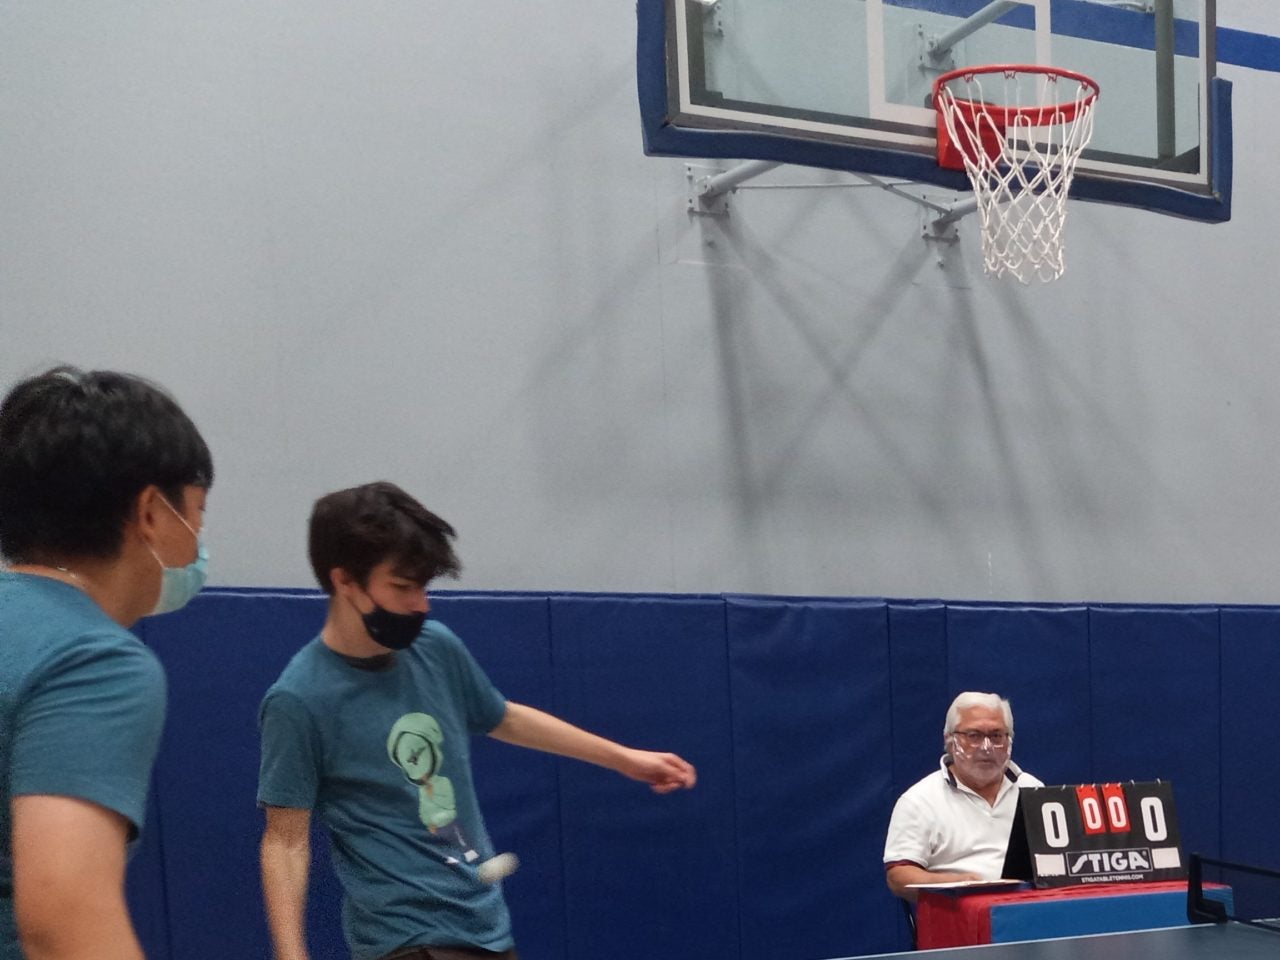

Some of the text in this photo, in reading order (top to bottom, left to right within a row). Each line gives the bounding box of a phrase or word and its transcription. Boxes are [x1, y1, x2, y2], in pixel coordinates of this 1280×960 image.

[1041, 802, 1069, 848] 0
[1140, 796, 1167, 841] 0
[1071, 851, 1149, 873] STIGA
